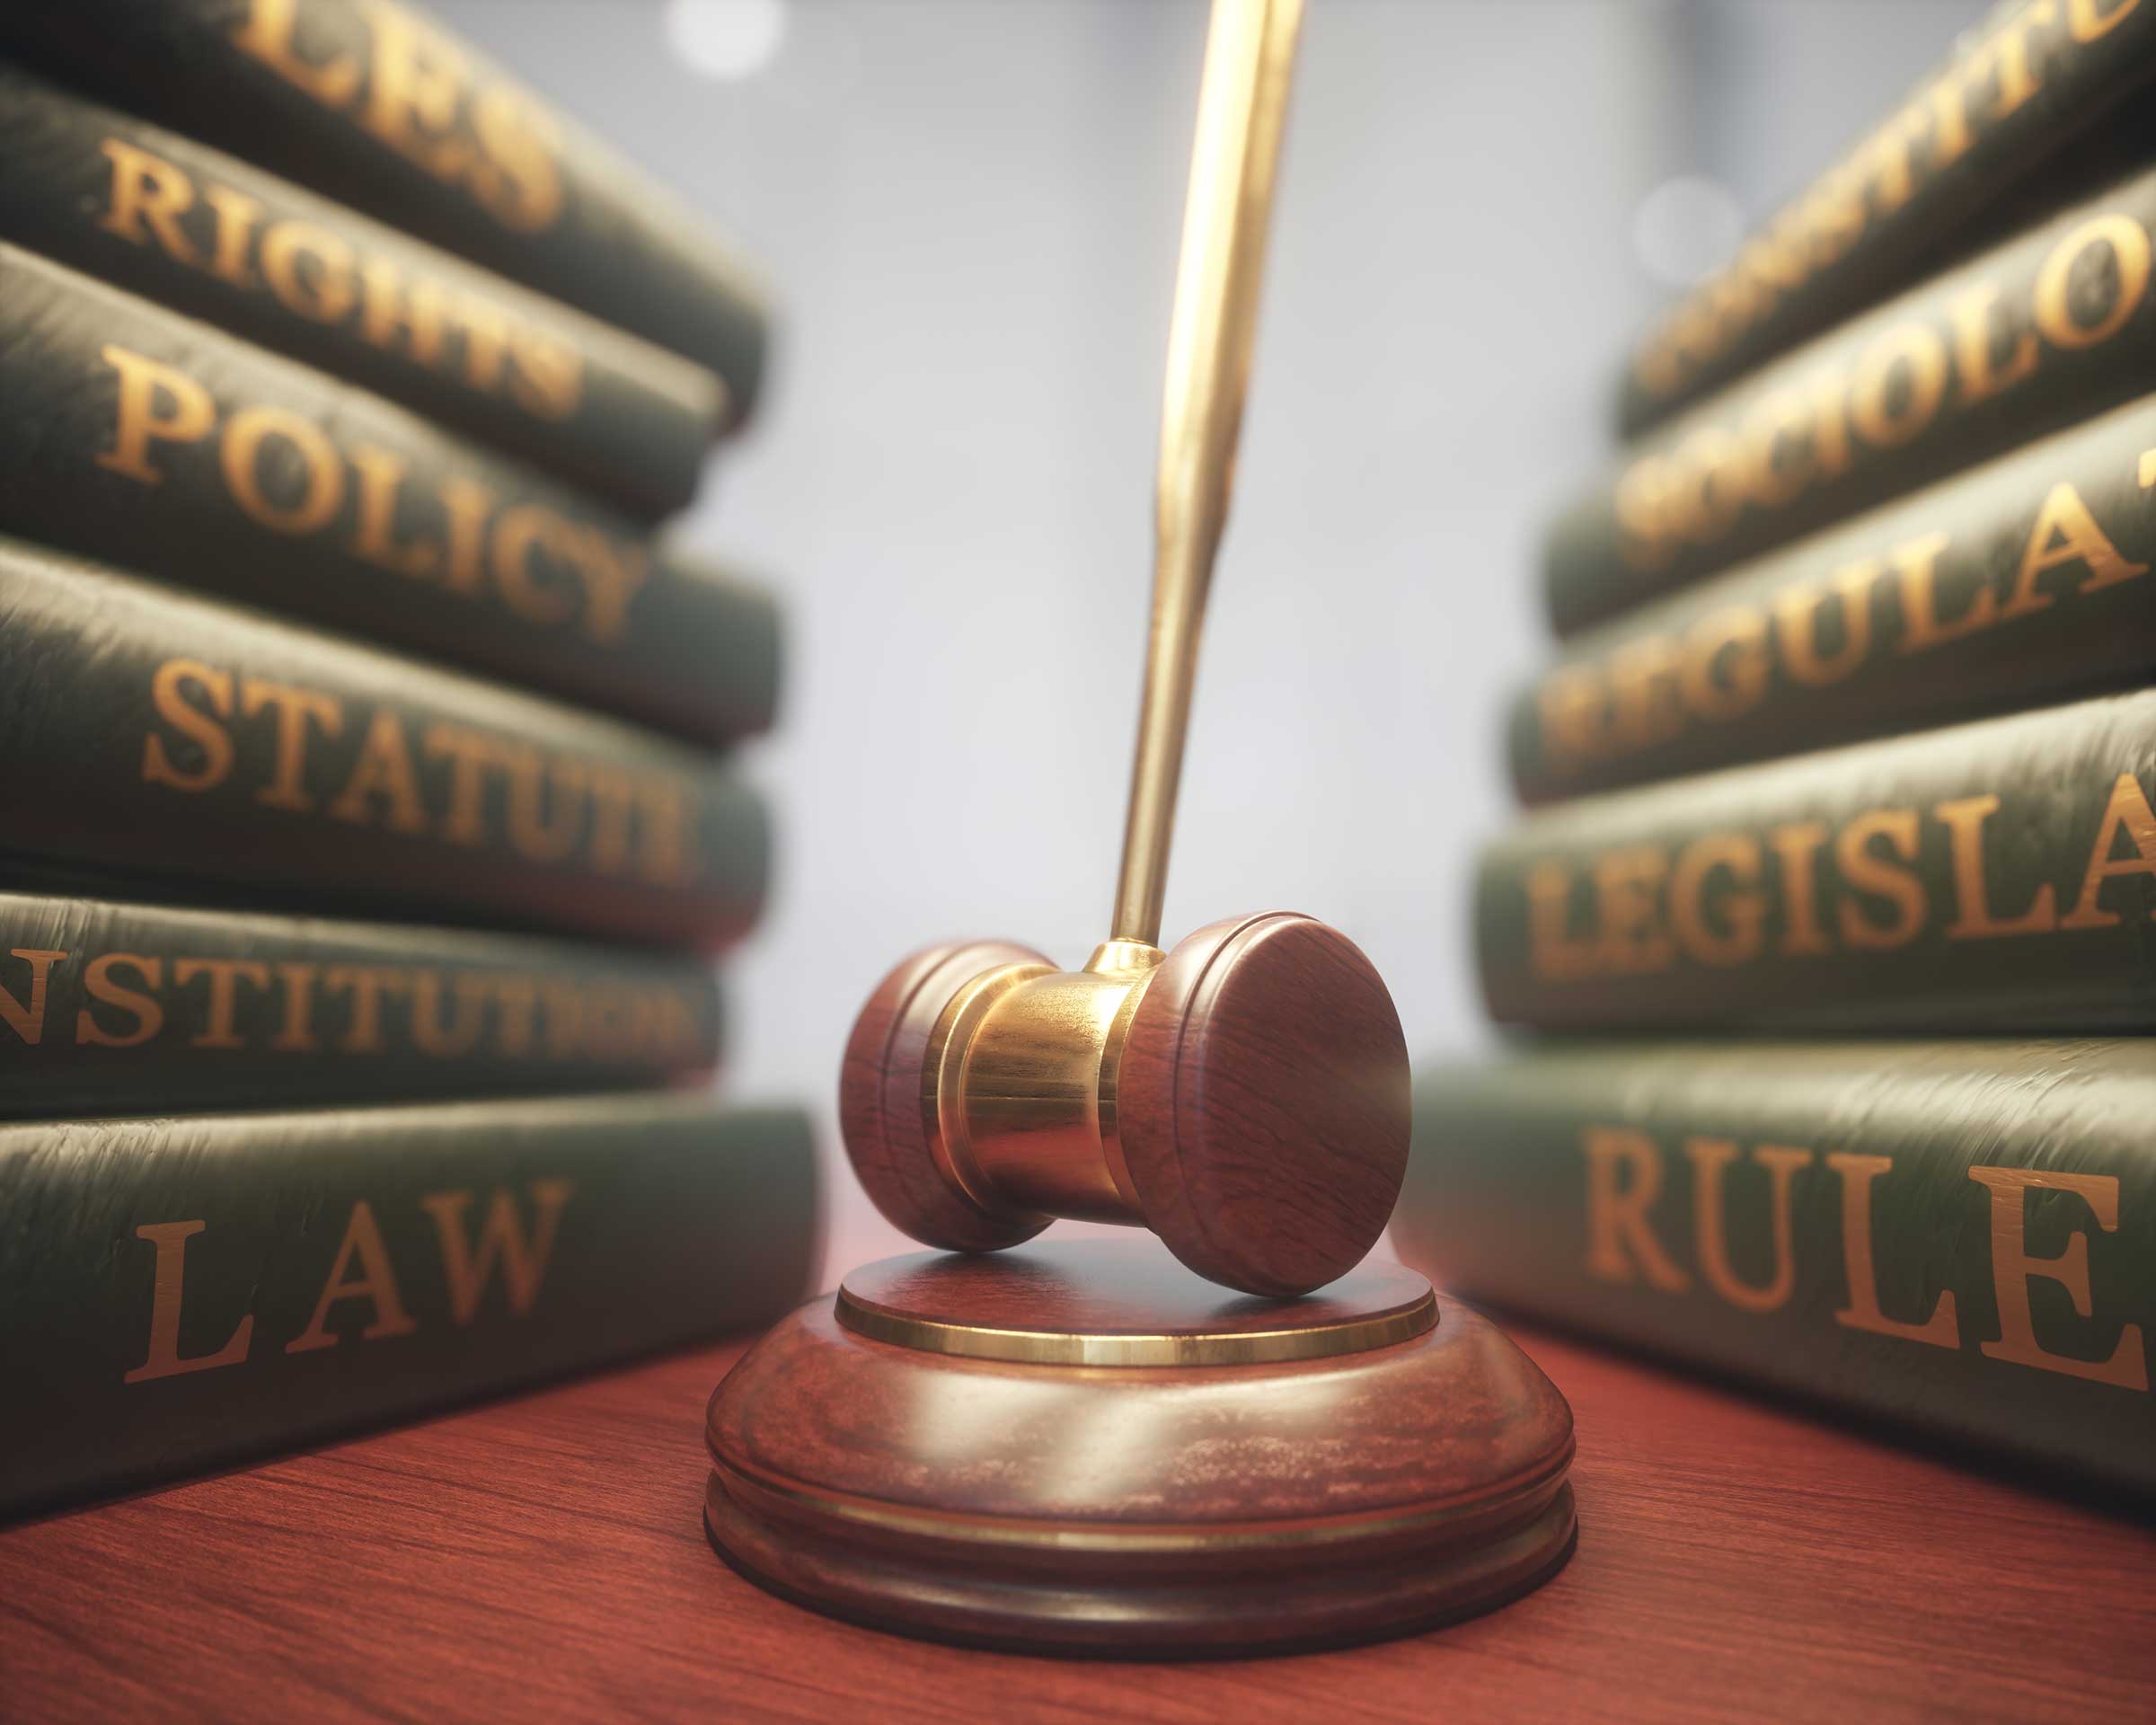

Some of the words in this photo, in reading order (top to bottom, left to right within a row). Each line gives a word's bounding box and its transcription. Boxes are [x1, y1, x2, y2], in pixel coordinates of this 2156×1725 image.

[101, 138, 582, 420] RIGHTS
[94, 345, 649, 643] POLICY
[142, 659, 702, 888] STATUTE
[124, 1178, 575, 1384] LAW
[1583, 1125, 2149, 1392] RULE
